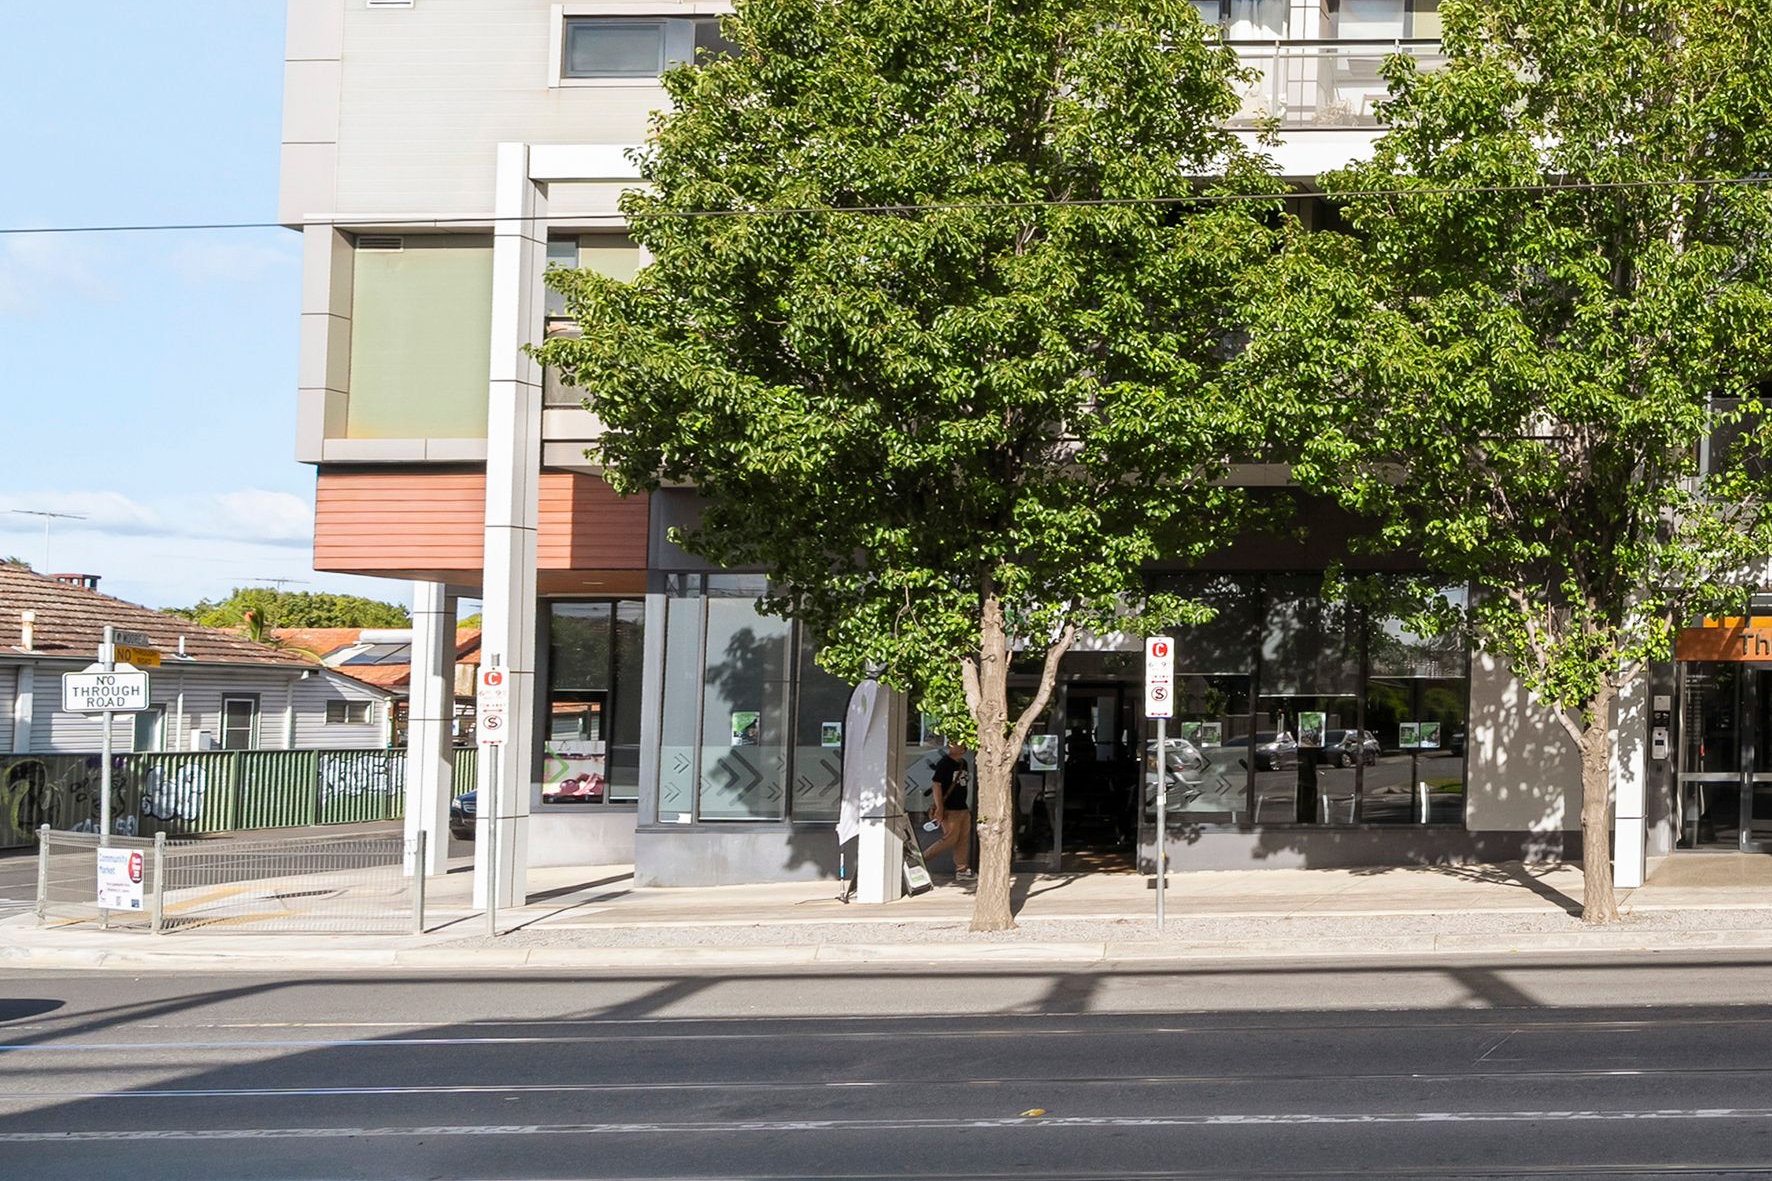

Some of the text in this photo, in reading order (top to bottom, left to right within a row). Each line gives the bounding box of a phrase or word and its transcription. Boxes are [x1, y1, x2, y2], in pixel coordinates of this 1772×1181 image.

[117, 648, 132, 661] NO
[96, 675, 115, 686] NO
[72, 685, 140, 697] THROUGH
[86, 697, 125, 707] ROAD
